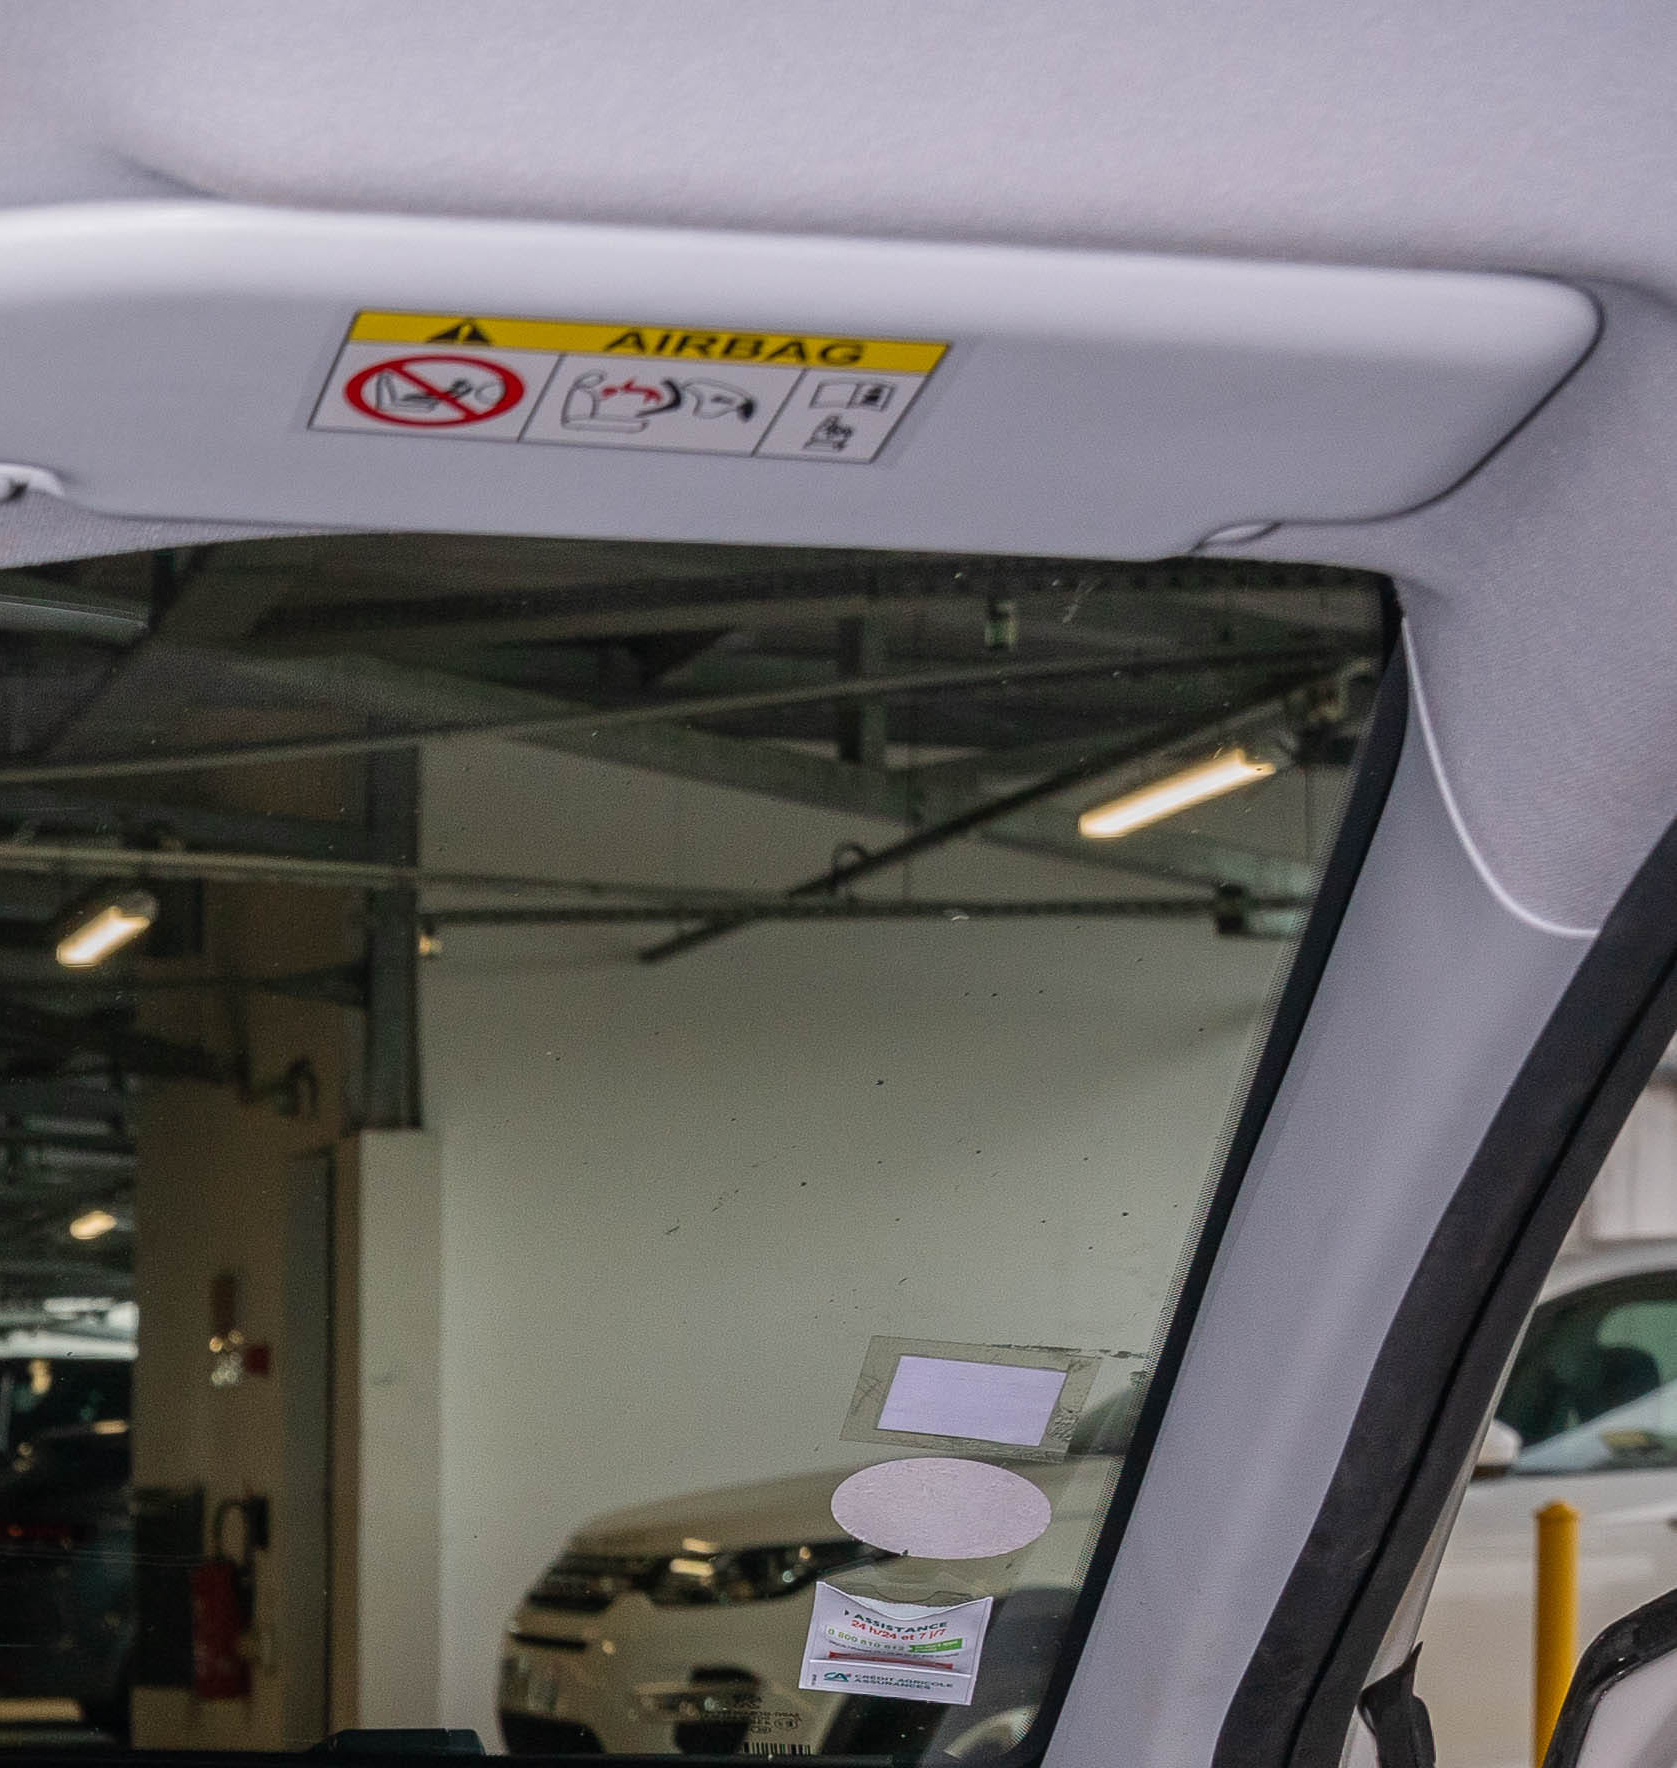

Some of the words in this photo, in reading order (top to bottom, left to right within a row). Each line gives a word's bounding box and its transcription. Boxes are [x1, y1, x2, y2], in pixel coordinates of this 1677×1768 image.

[604, 328, 864, 366] AIRBAG
[850, 1620, 867, 1631] 24
[869, 1626, 897, 1639] h/24
[901, 1633, 915, 1641] et
[854, 1614, 947, 1633] ASSISTANCE
